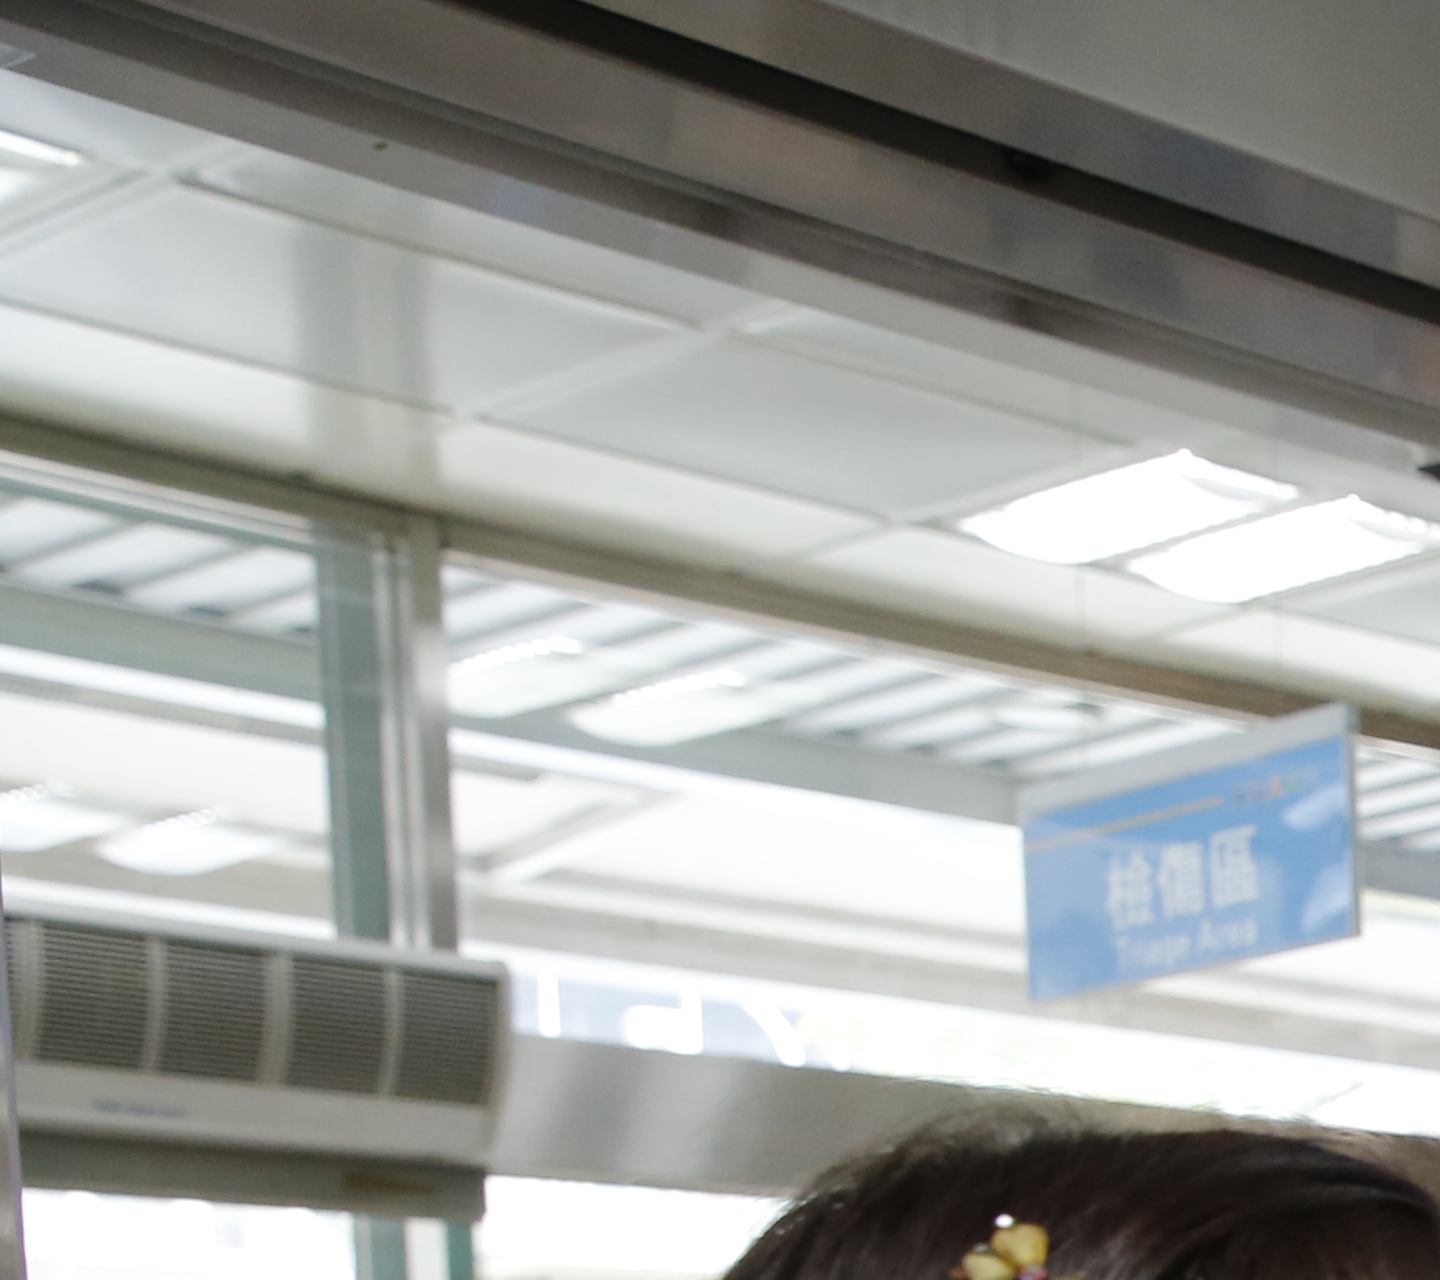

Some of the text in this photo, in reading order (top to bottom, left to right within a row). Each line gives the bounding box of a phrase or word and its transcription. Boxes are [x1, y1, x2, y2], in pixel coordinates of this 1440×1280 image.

[1105, 825, 1260, 930] 檢傷區
[1117, 918, 1259, 968] Triage Area
